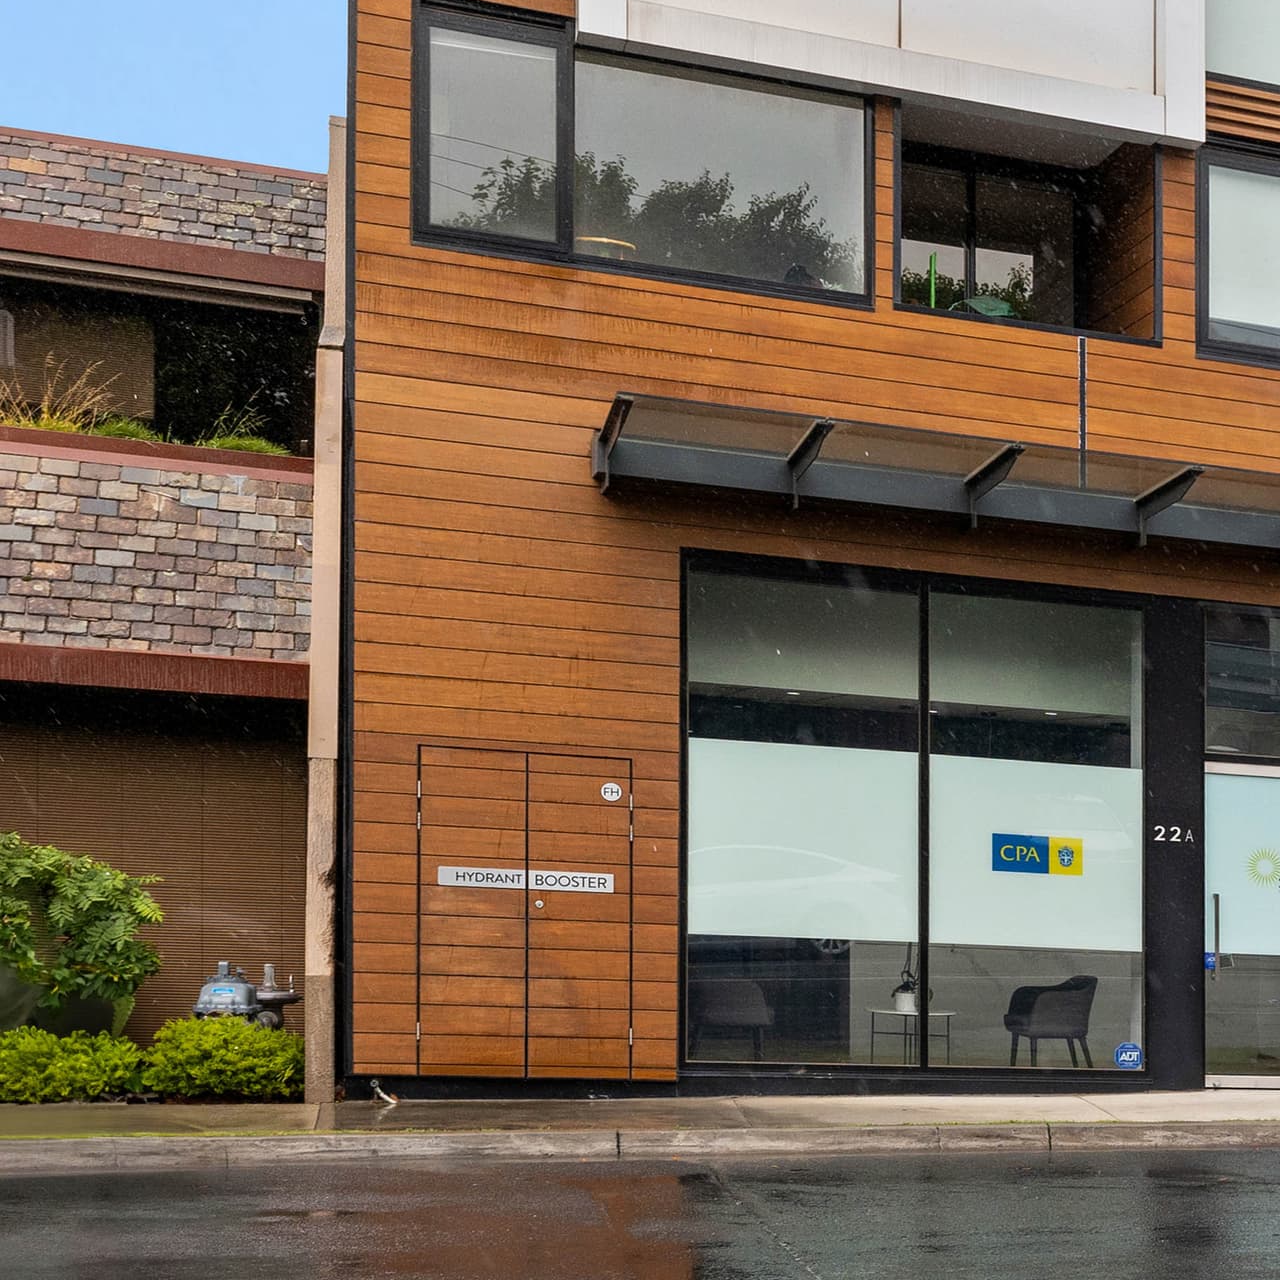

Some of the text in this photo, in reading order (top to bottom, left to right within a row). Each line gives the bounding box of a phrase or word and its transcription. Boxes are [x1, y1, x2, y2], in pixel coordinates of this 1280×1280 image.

[603, 786, 620, 798] FH
[1000, 843, 1041, 863] CPA
[455, 871, 608, 889] HYDRANT BOOSTER
[1119, 1051, 1140, 1062] ADT
